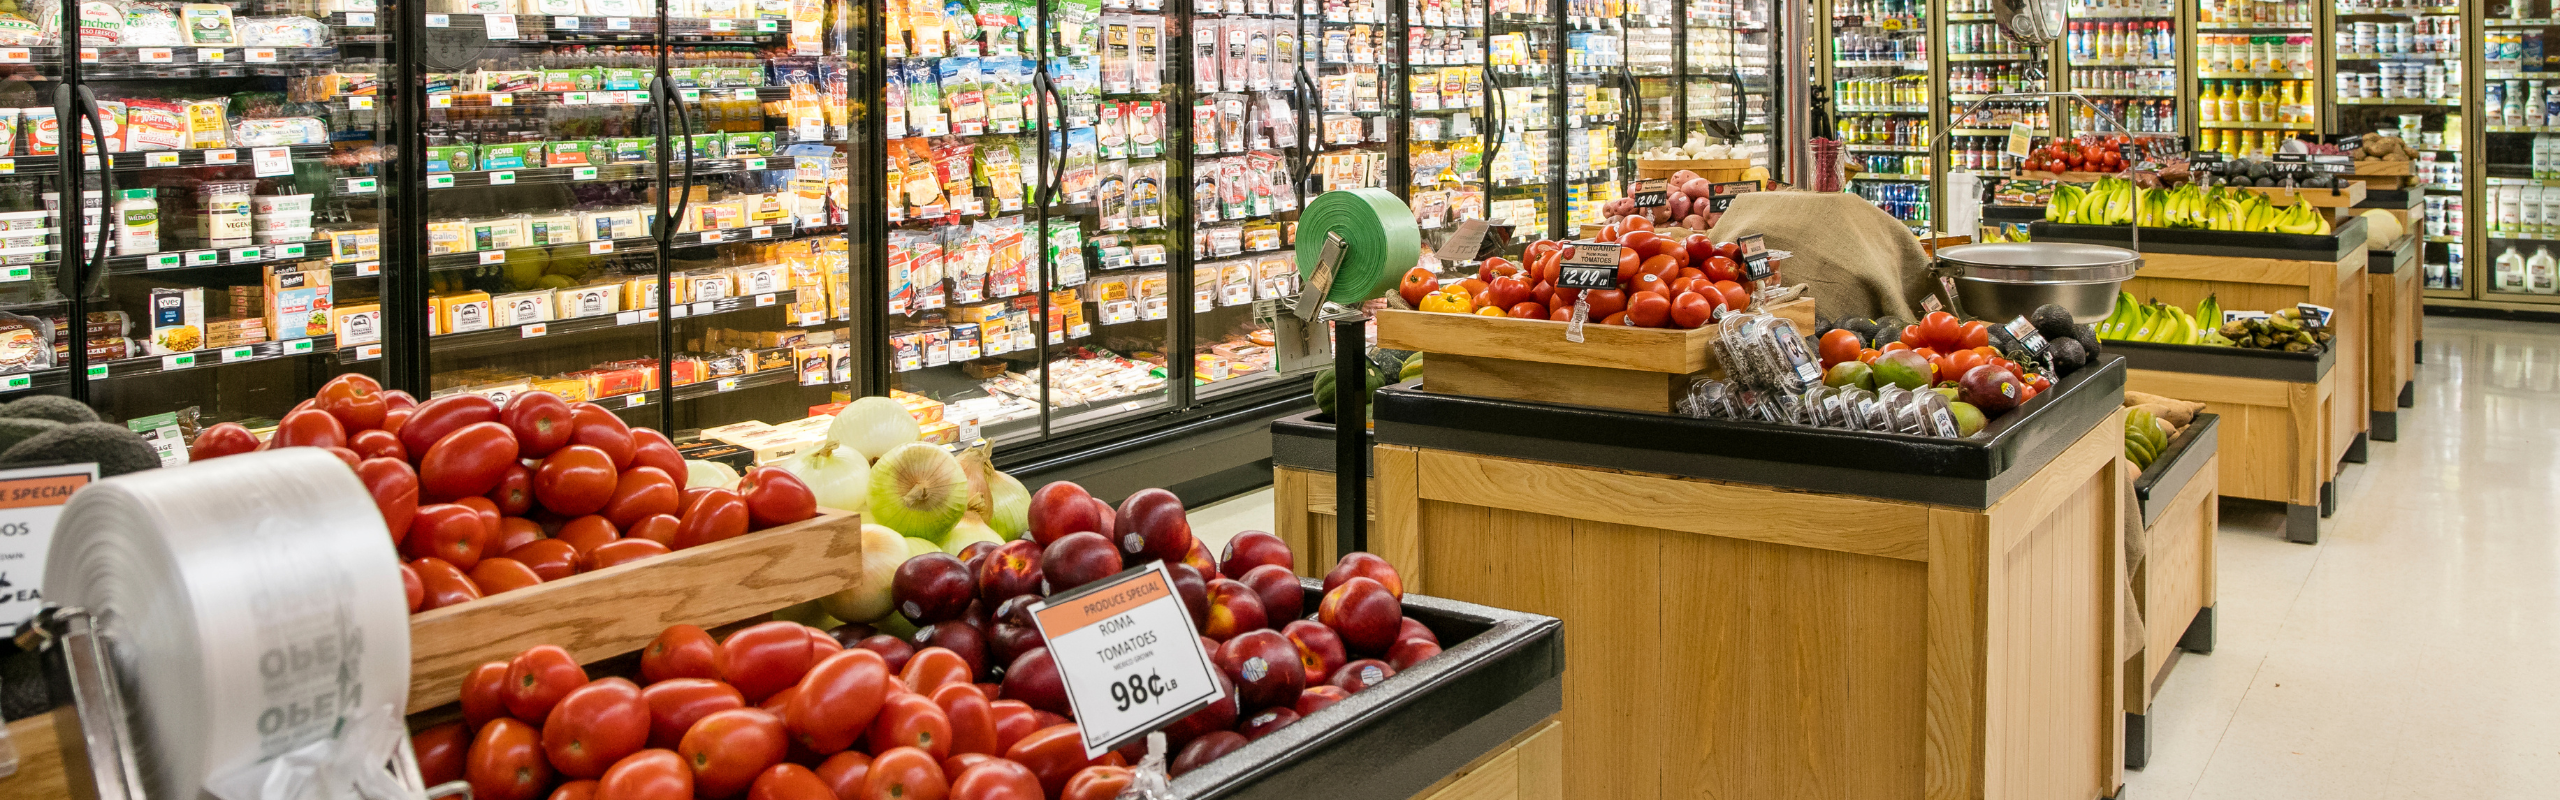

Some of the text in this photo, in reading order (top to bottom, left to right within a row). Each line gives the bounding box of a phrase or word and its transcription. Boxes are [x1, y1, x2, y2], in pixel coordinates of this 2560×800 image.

[1066, 2, 1087, 10] CLOVER
[141, 113, 162, 123] JOSEPH
[282, 276, 303, 285] Tofurky
[1563, 269, 1600, 285] $2.99
[776, 449, 796, 458] Tillamook
[1084, 581, 1160, 616] PRODUCE SPECIAL
[1099, 614, 1135, 637] ROMA
[1096, 630, 1158, 664] TOMATOES
[1113, 650, 1154, 671] MEXICO GROWN
[1111, 667, 1178, 712] 98¢ LB
